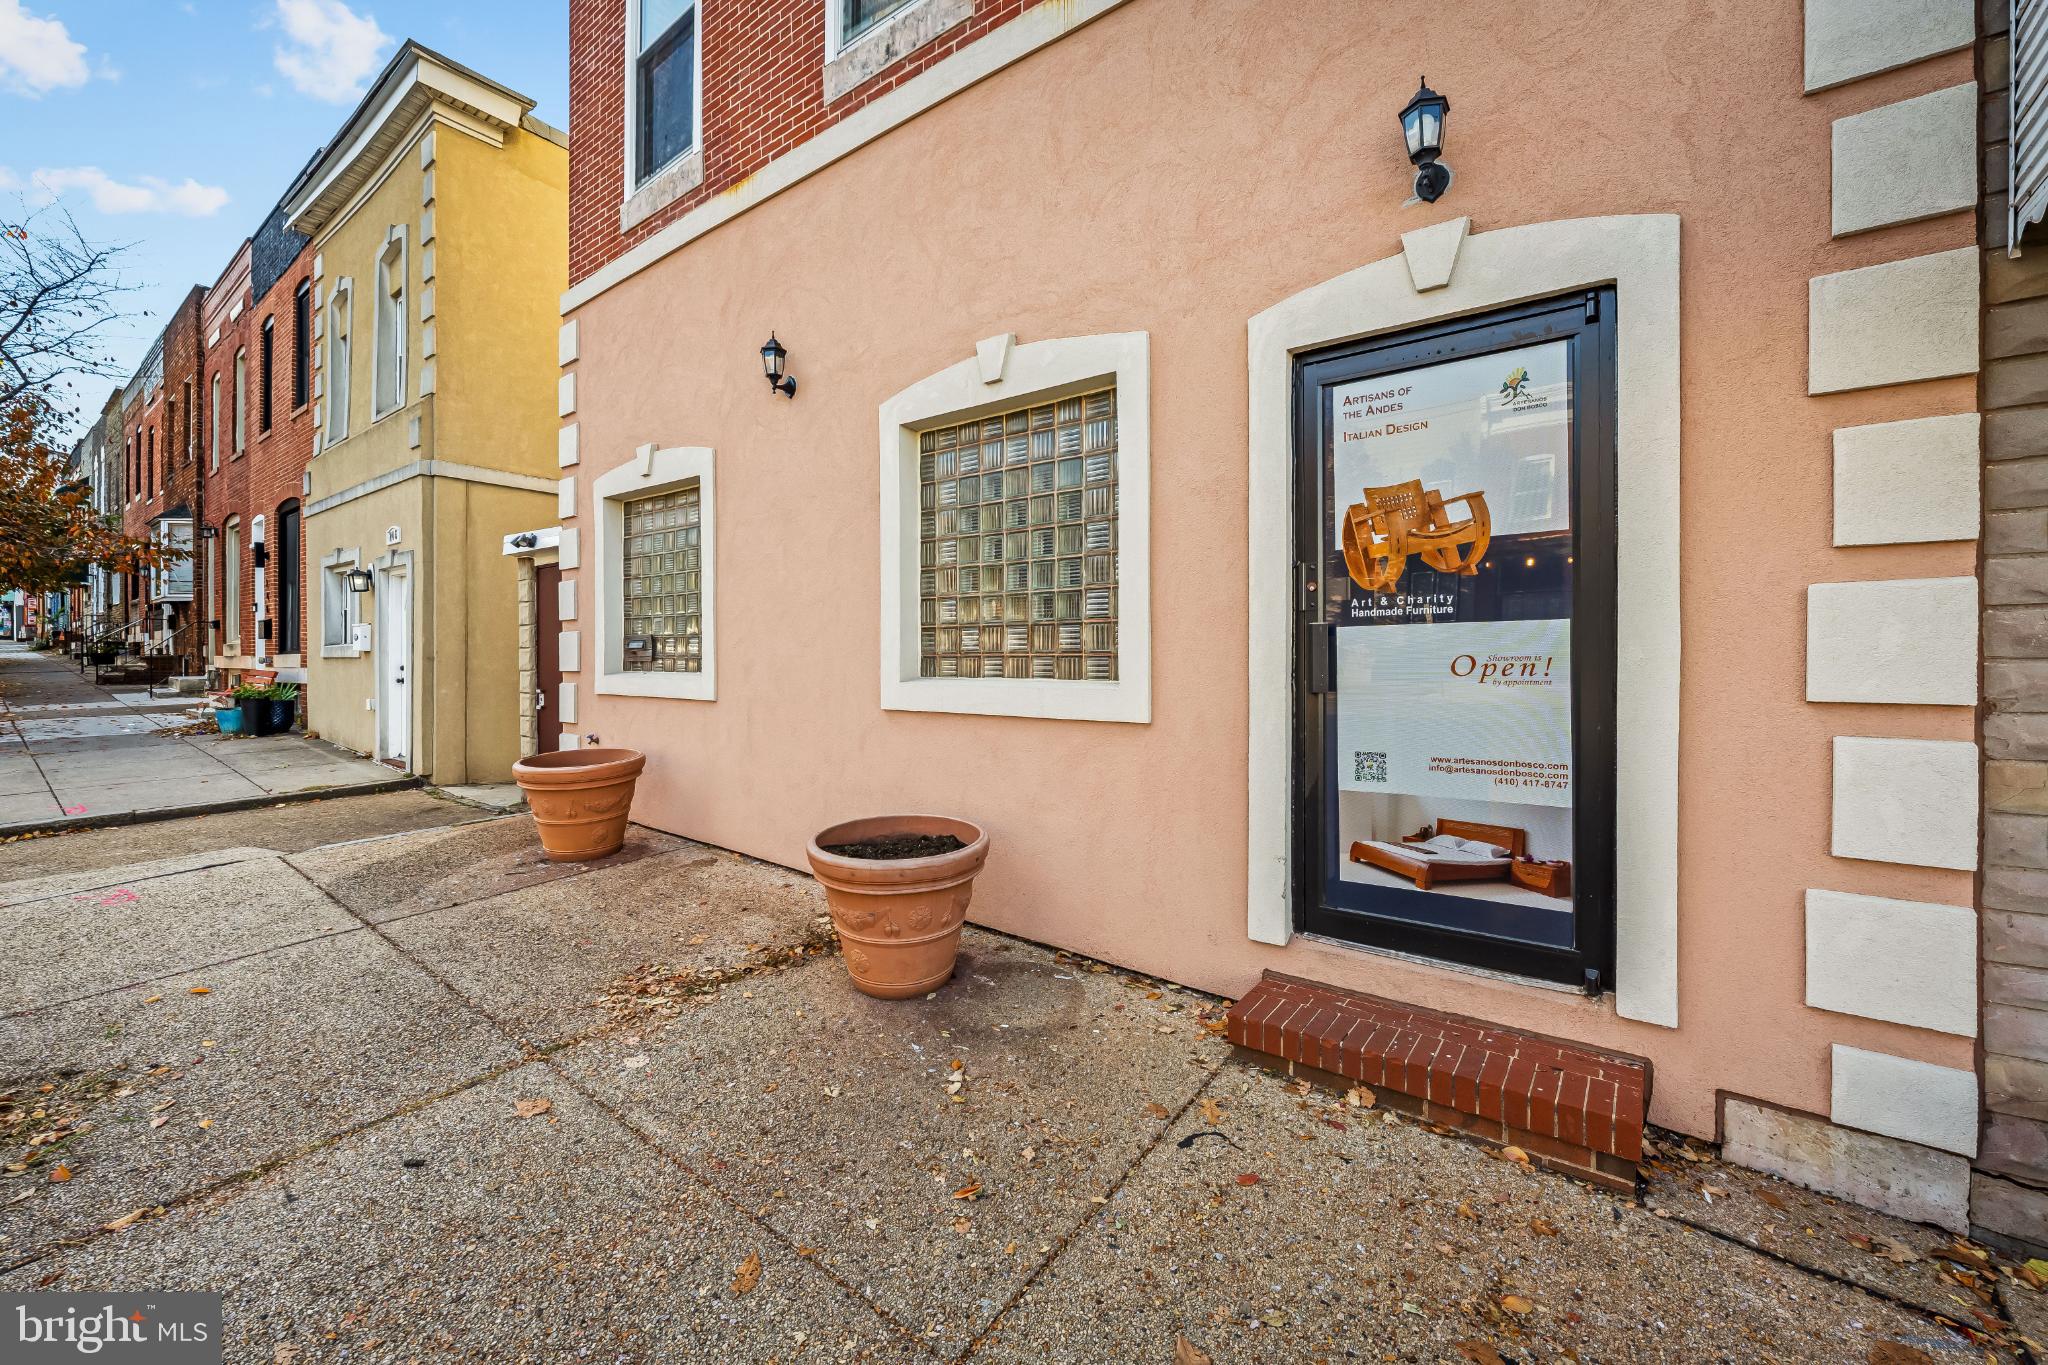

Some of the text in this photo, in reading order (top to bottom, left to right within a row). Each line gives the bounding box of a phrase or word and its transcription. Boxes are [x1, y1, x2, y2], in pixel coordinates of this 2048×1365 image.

[1351, 594, 1454, 607] Art & Charity
[1351, 605, 1454, 618] Handmade Furniture
[1486, 654, 1532, 662] Showroom
[1450, 654, 1553, 684] Open!
[1492, 678, 1553, 687] by appointment
[1430, 756, 1569, 771] www.artesanosdonbosco.com
[1428, 764, 1569, 780] info@artesanosdonbosco.com
[1494, 777, 1569, 789] (410) 417-8747
